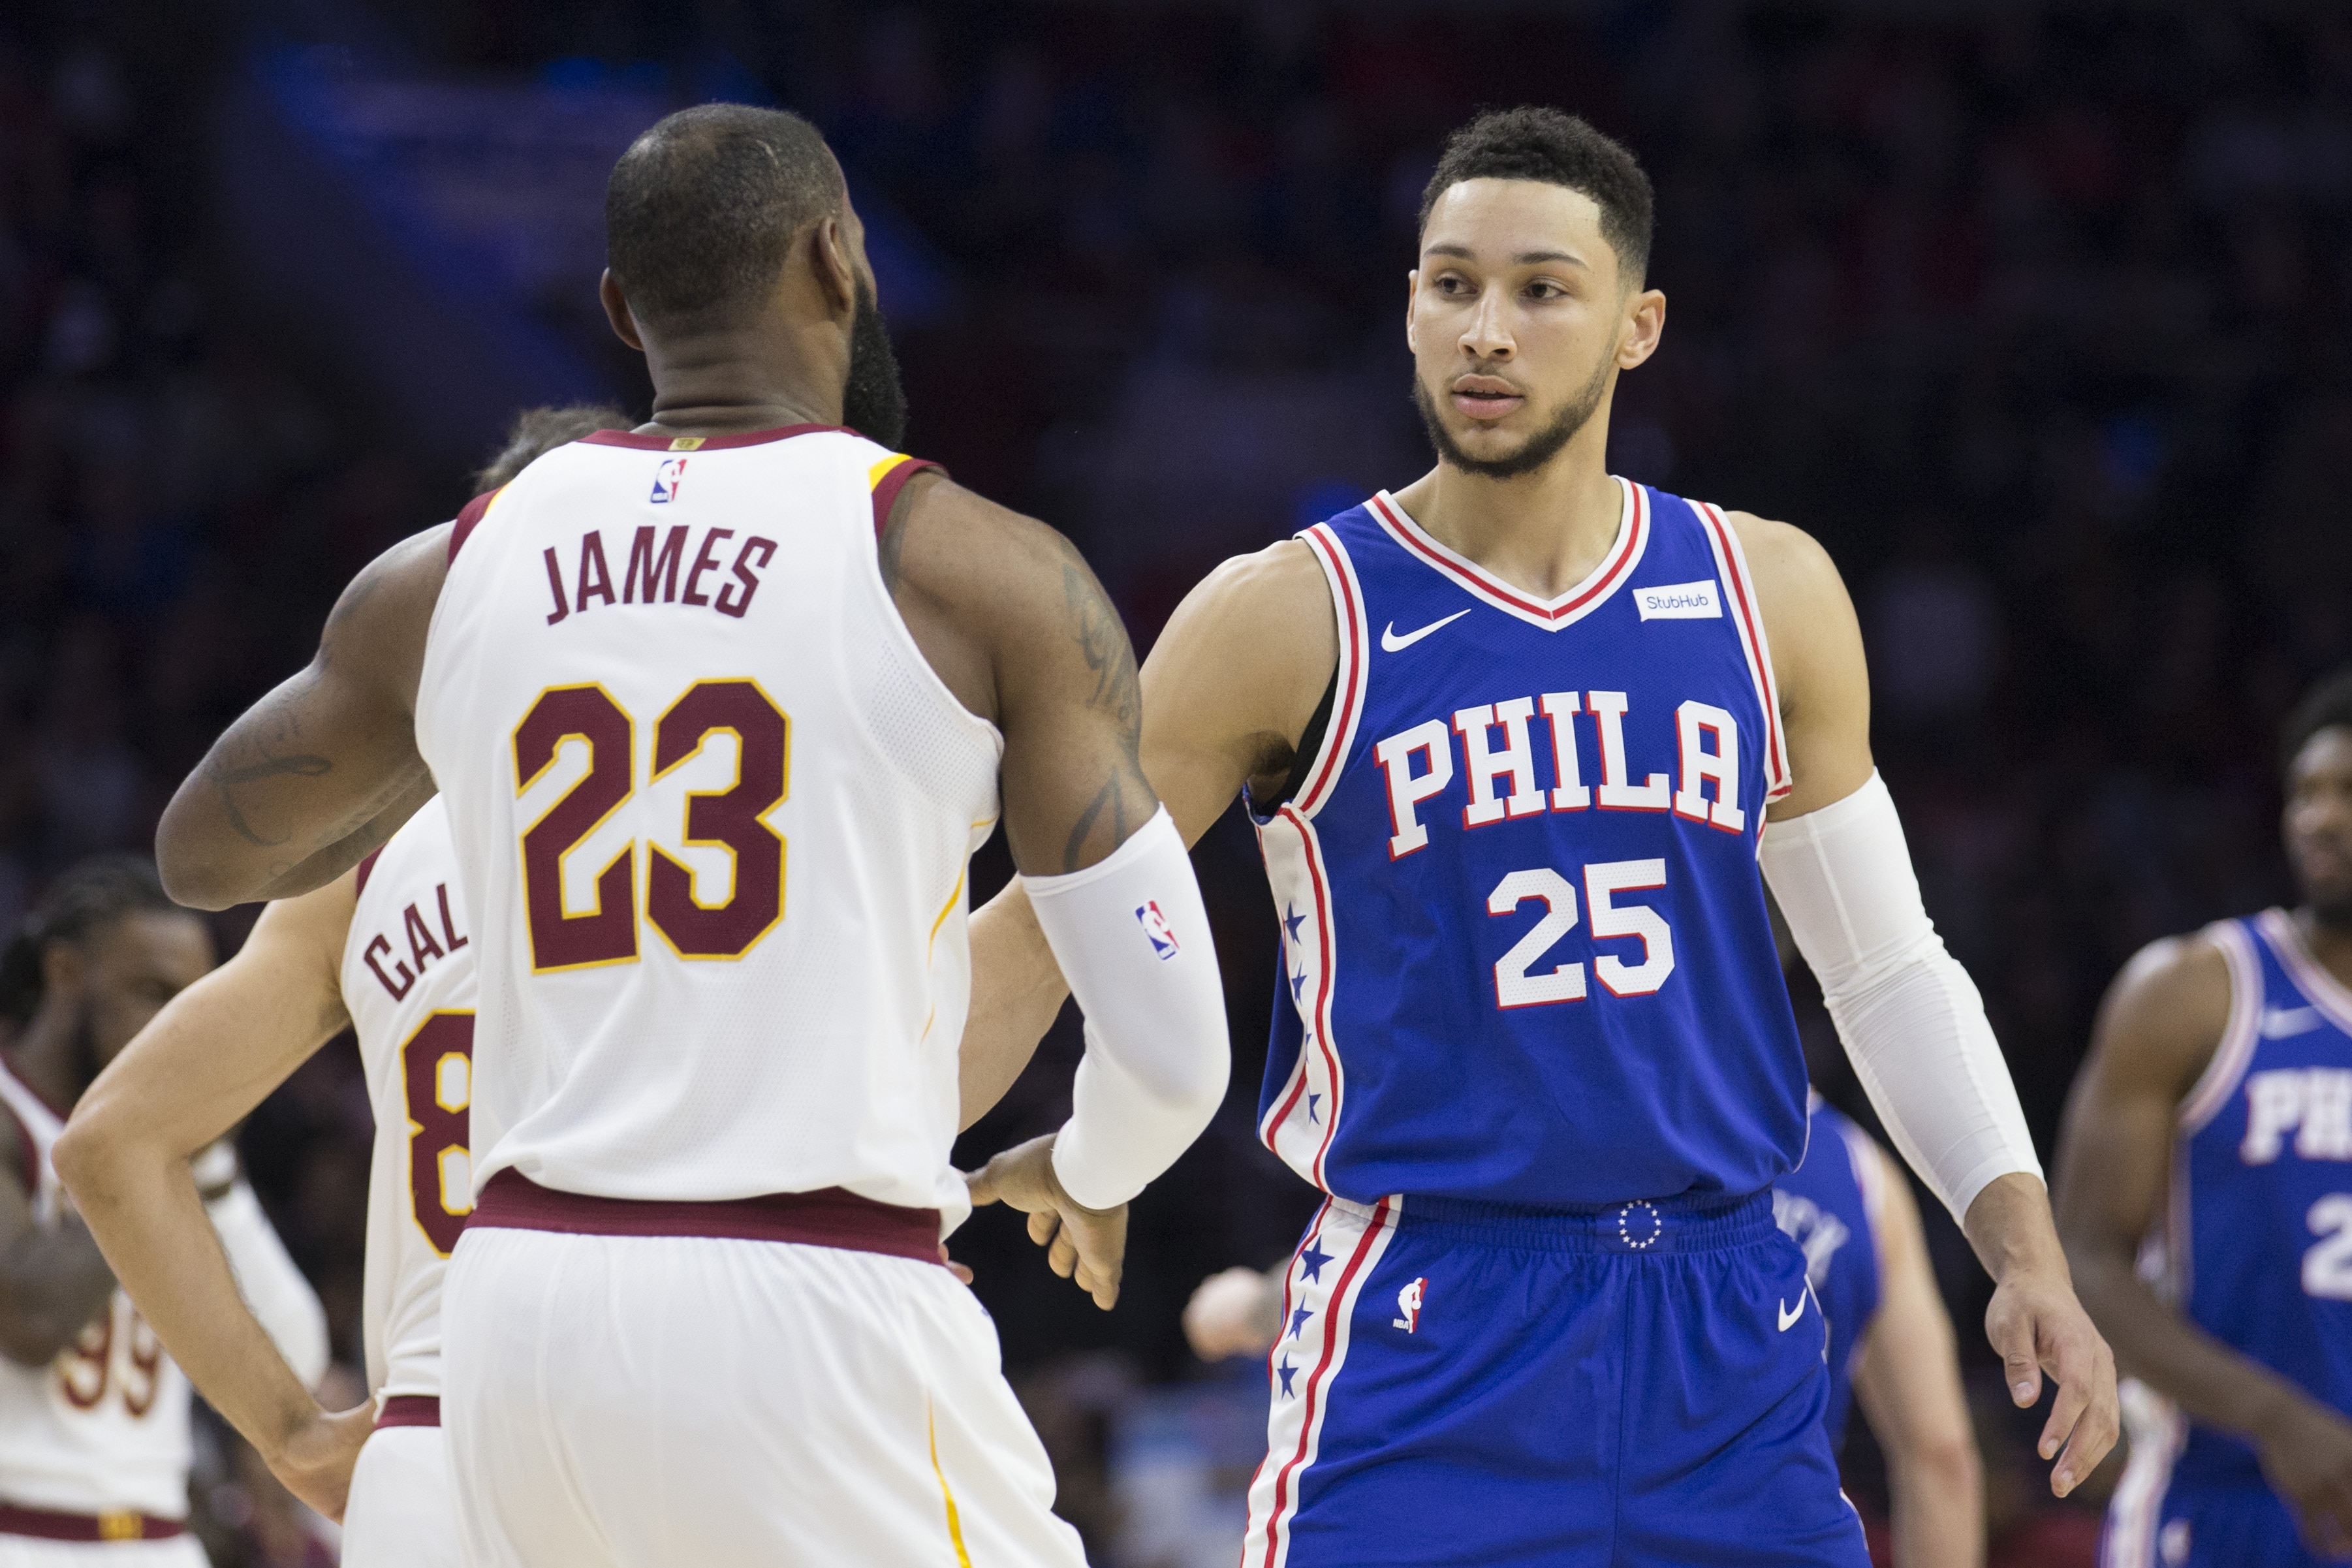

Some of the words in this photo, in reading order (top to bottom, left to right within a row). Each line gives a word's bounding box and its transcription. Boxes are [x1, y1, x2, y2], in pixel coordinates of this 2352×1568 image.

[543, 525, 778, 627] JAMES
[1646, 593, 1708, 610] StubHub
[510, 676, 792, 975] 23
[1373, 690, 1745, 862] PHILA
[1486, 858, 1676, 1011] 25
[1393, 1318, 1409, 1330] NBA
